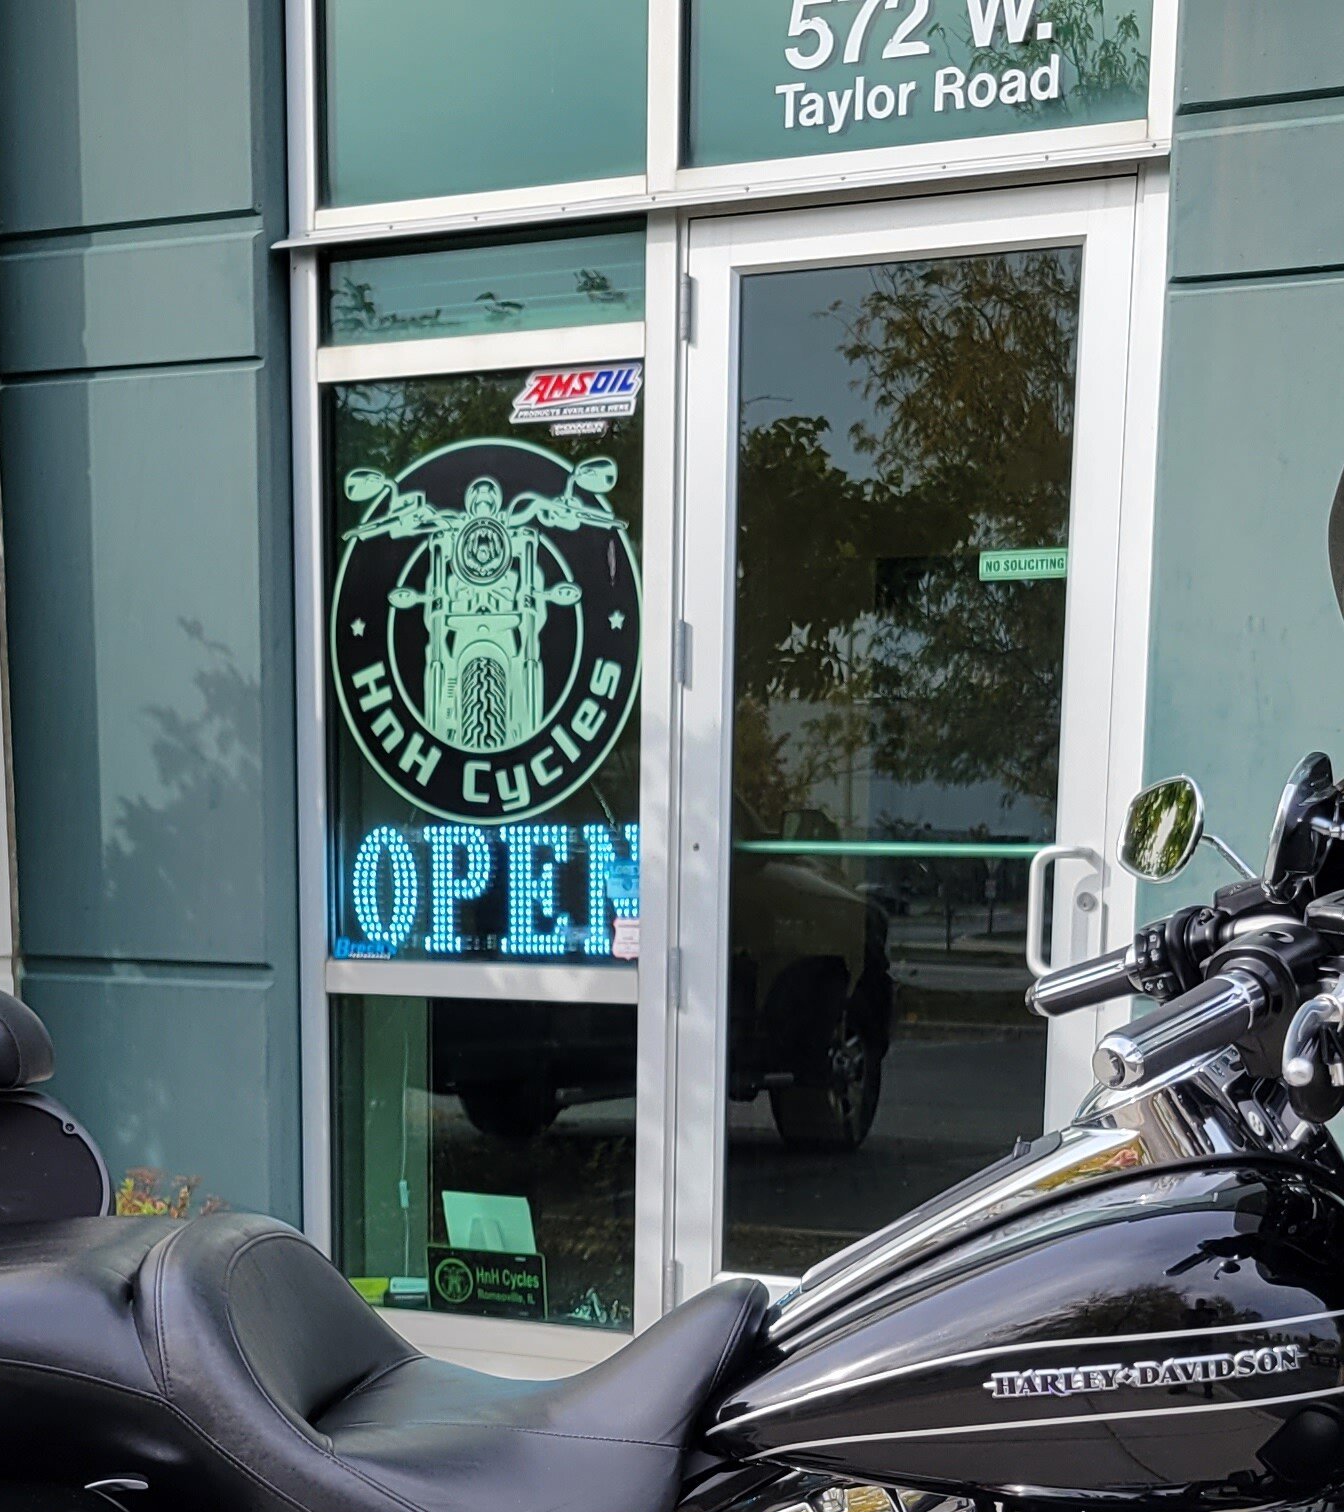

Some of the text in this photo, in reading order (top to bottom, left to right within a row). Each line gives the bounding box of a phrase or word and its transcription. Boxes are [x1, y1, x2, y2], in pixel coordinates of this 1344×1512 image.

[784, 0, 1053, 70] 572 W.
[775, 54, 1060, 134] Taylor Road
[518, 407, 560, 419] PRODUCTS
[561, 404, 606, 416] AVAILABLE
[524, 368, 635, 405] AMSOIL
[985, 557, 1065, 573] NO SOLICITING
[462, 658, 622, 812] Cycles
[352, 824, 640, 956] OPEN
[476, 1266, 540, 1291] HnH Cycles
